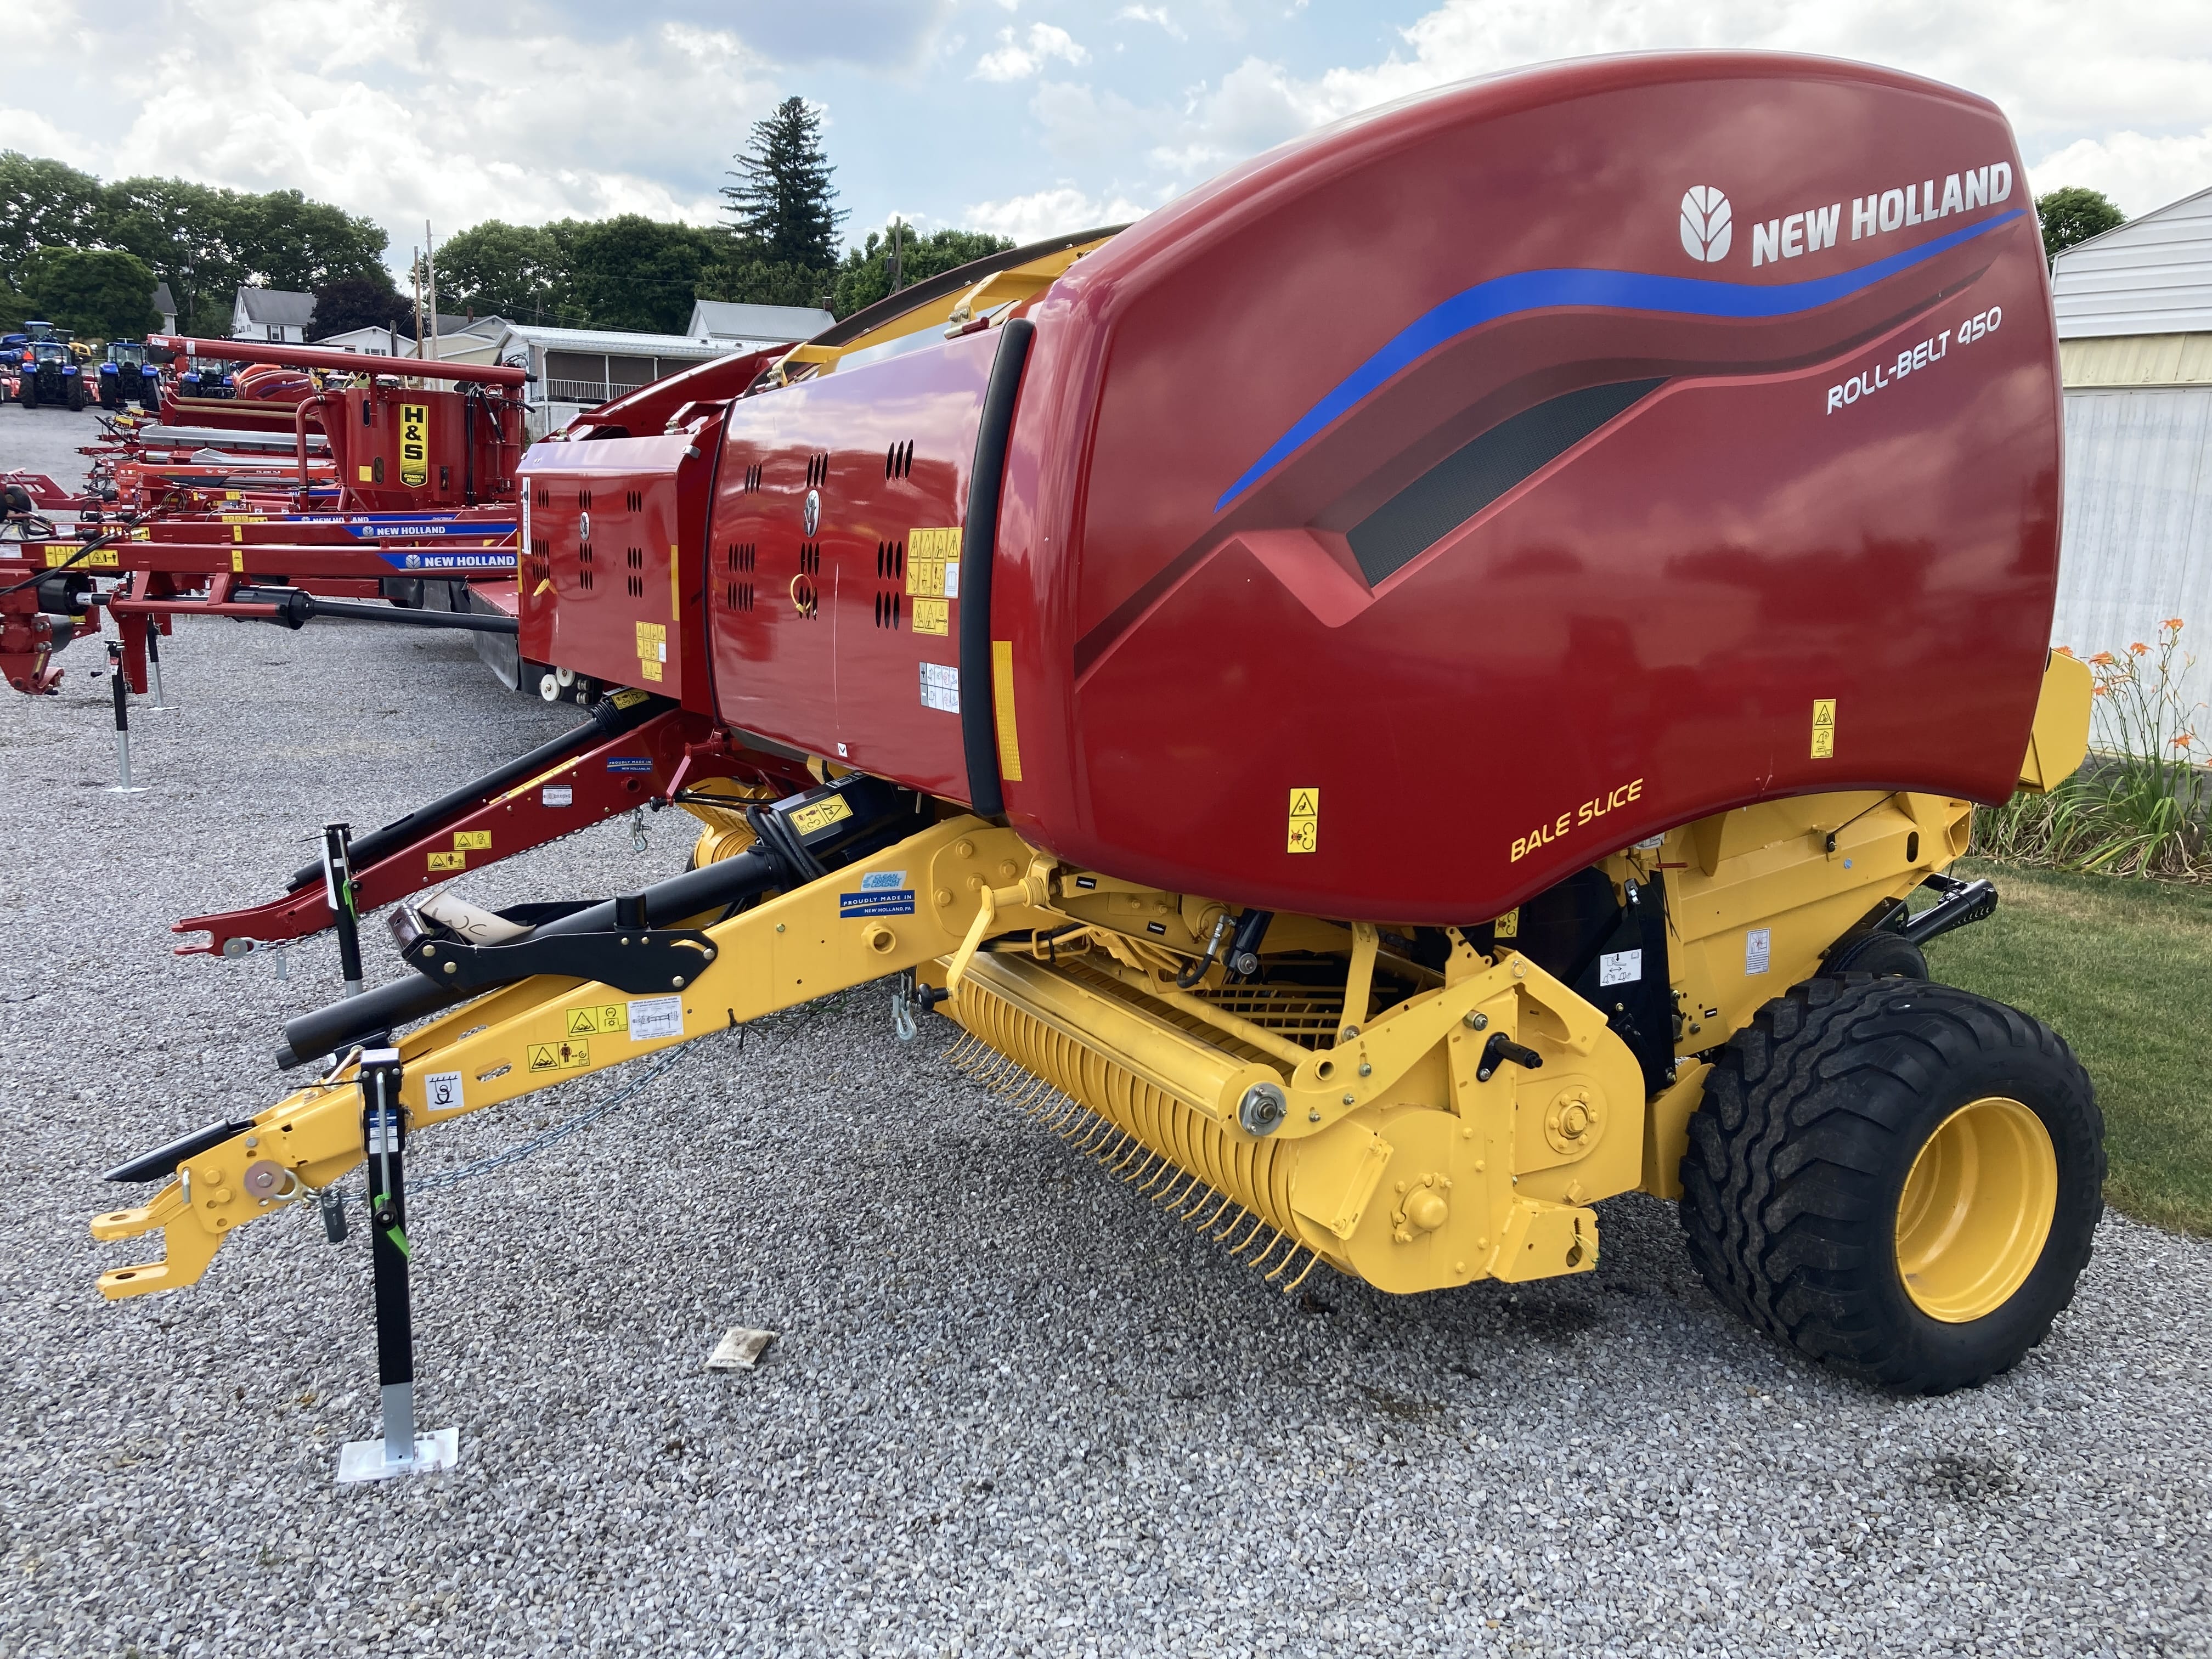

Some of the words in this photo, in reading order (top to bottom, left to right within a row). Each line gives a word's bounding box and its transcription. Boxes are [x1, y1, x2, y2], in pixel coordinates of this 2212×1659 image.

[1752, 203, 1841, 268] NEW
[1851, 160, 2012, 242] HOLLAND
[1826, 329, 1951, 415] ROLL-BELT
[1957, 305, 2003, 345] 450
[377, 527, 399, 536] NEW
[400, 526, 446, 535] HOLLAND
[425, 556, 455, 567] NEW
[456, 555, 515, 567] HOLLAND
[1510, 812, 1572, 863] BALE
[1577, 778, 1644, 827] SLICE
[843, 897, 878, 906] PROUDLY
